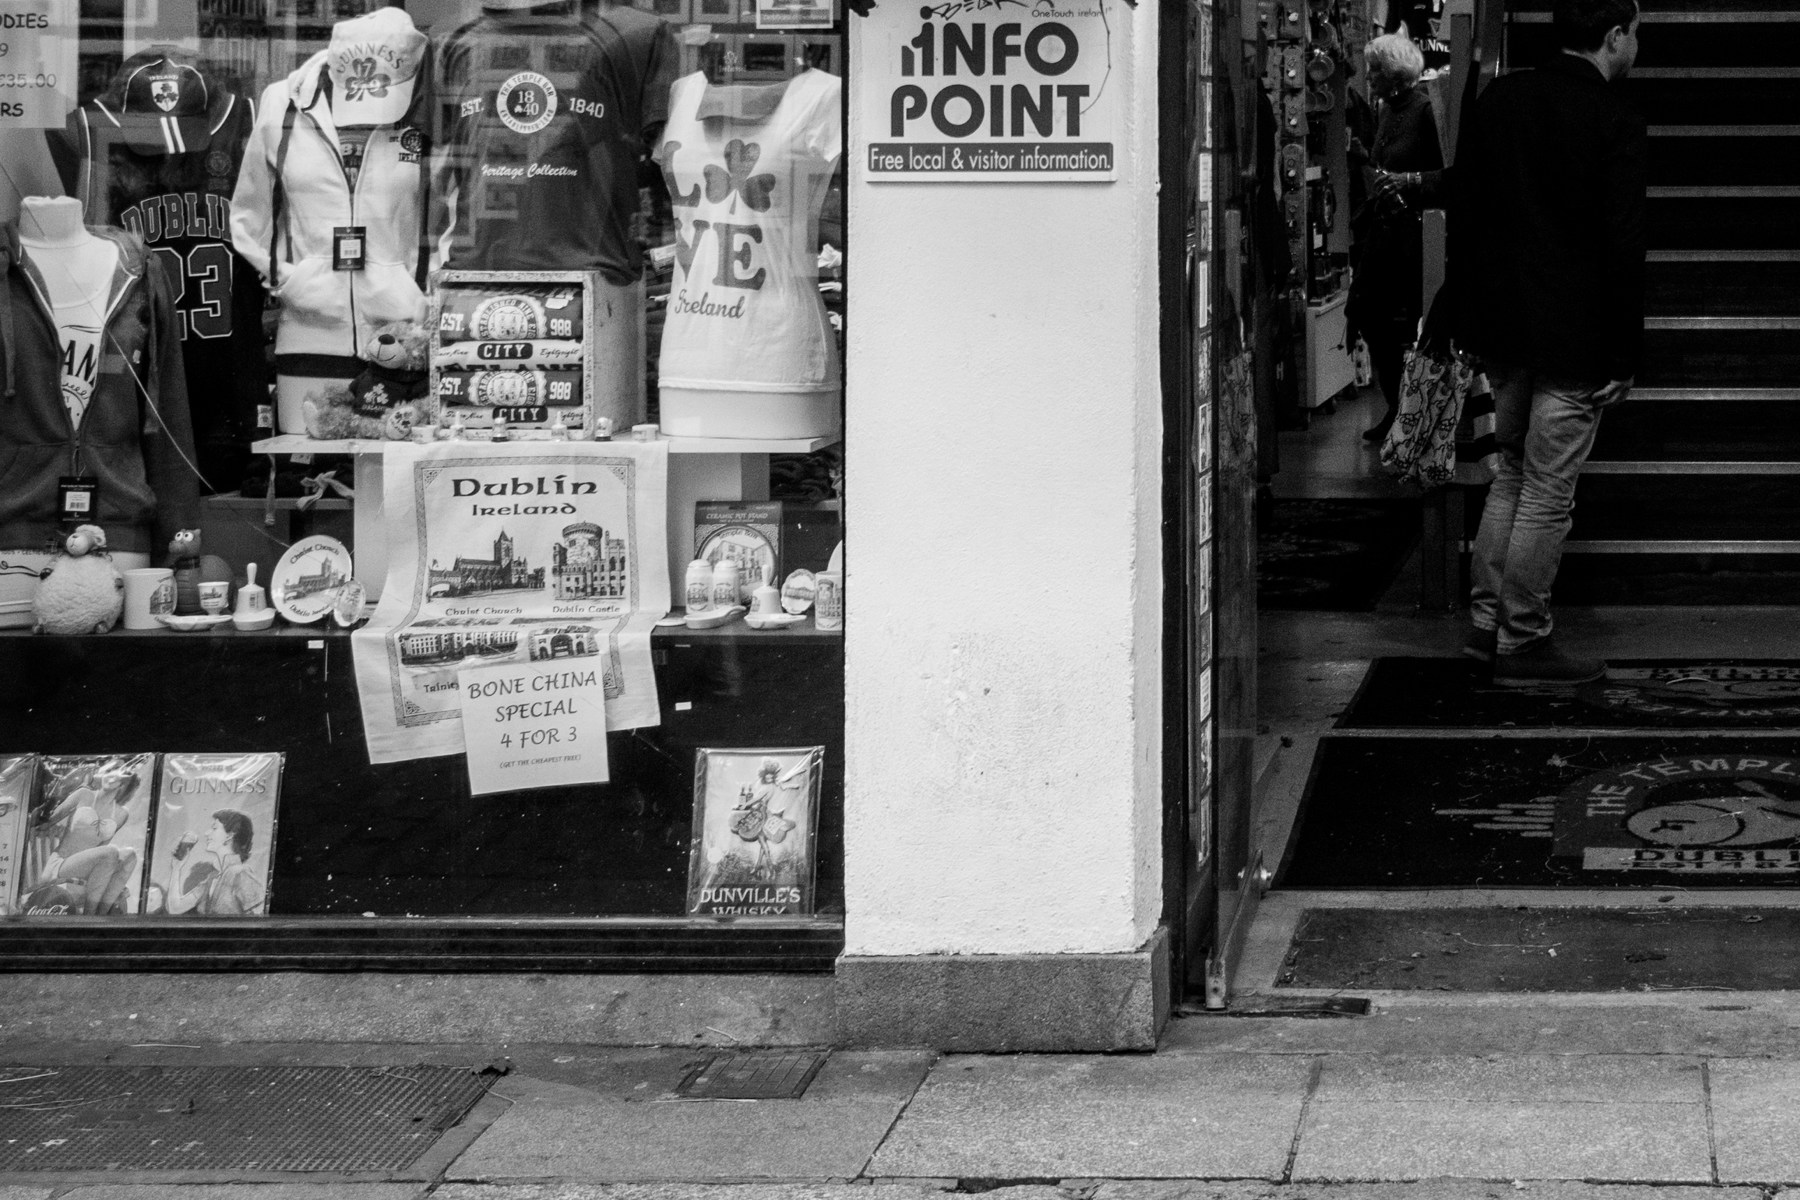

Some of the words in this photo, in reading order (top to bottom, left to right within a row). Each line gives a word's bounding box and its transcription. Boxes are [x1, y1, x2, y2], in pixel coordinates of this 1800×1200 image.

[336, 42, 404, 75] GUINNESS
[517, 90, 535, 104] 18
[461, 97, 485, 118] EST.
[523, 102, 540, 116] 40
[569, 97, 605, 119] 1840
[890, 83, 1090, 138] POINT
[869, 147, 904, 170] Free
[909, 147, 945, 170] local
[951, 148, 964, 170] &
[969, 147, 1014, 170] visitor
[1020, 147, 1111, 170] information.
[674, 289, 746, 319] Ireland
[440, 312, 465, 332] EST.
[550, 318, 573, 337] 988
[483, 343, 526, 359] CITY
[440, 377, 464, 396] EST.
[549, 381, 572, 401] 988
[499, 407, 541, 422] CITY
[472, 502, 577, 517] Ireland
[483, 606, 523, 616] Church
[552, 605, 585, 614] Dublin
[587, 605, 621, 614] Castle
[468, 677, 526, 700] BONE
[531, 671, 598, 692] CHINA
[495, 698, 578, 723] SPECIAL
[500, 732, 513, 749] 4
[519, 728, 561, 749] FOR
[567, 726, 578, 742] 3
[517, 759, 530, 767] THE
[531, 756, 562, 766] CHEAPEST
[170, 776, 267, 796] GUINNESS
[1586, 783, 1635, 817] THE
[700, 886, 800, 903] DUNVILLE'S
